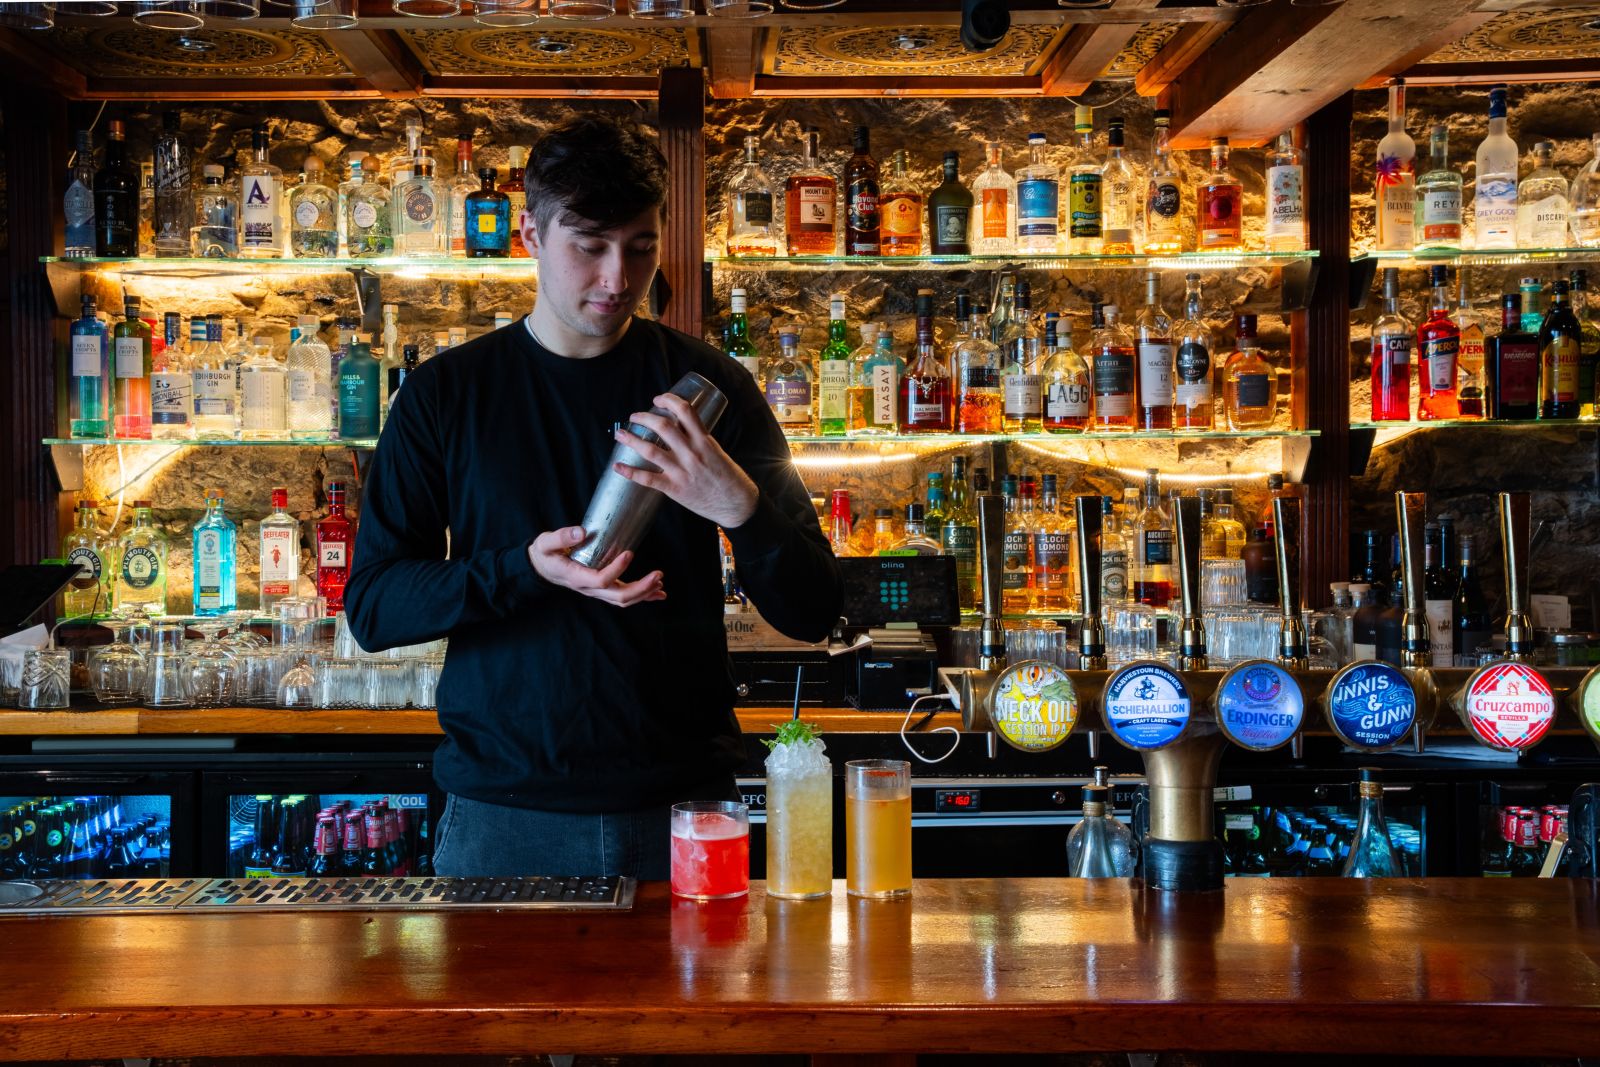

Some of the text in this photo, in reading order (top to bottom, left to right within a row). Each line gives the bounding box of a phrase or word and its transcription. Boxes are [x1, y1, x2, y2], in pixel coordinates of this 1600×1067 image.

[1389, 339, 1409, 350] CAM
[195, 372, 231, 380] EDINBURGH
[881, 369, 890, 421] RAASAY
[1048, 384, 1088, 404] LAGG
[263, 531, 290, 540] BEEFEATER
[951, 528, 971, 537] GLEN
[1045, 535, 1066, 543] LOCH
[948, 536, 974, 545] SCOTIA
[1038, 543, 1069, 551] LOMOND
[123, 548, 158, 570] PLYMOUTH GIN
[327, 551, 340, 561] 24
[735, 620, 755, 633] One
[1113, 668, 1183, 693] HARVIESTOUN BREWERY
[1336, 674, 1390, 702] INNIS
[1112, 703, 1186, 715] SCHIEHALLION
[1367, 694, 1383, 711] &
[1475, 698, 1550, 716] Cruzcampo
[997, 700, 1075, 723] NECK OIL
[1227, 709, 1295, 727] ERDINGER
[1360, 703, 1412, 730] GUNN
[1005, 723, 1067, 736] SESSION IPA
[1355, 731, 1390, 740] SESSION
[388, 794, 426, 808] KOOL
[742, 794, 766, 805] EFC
